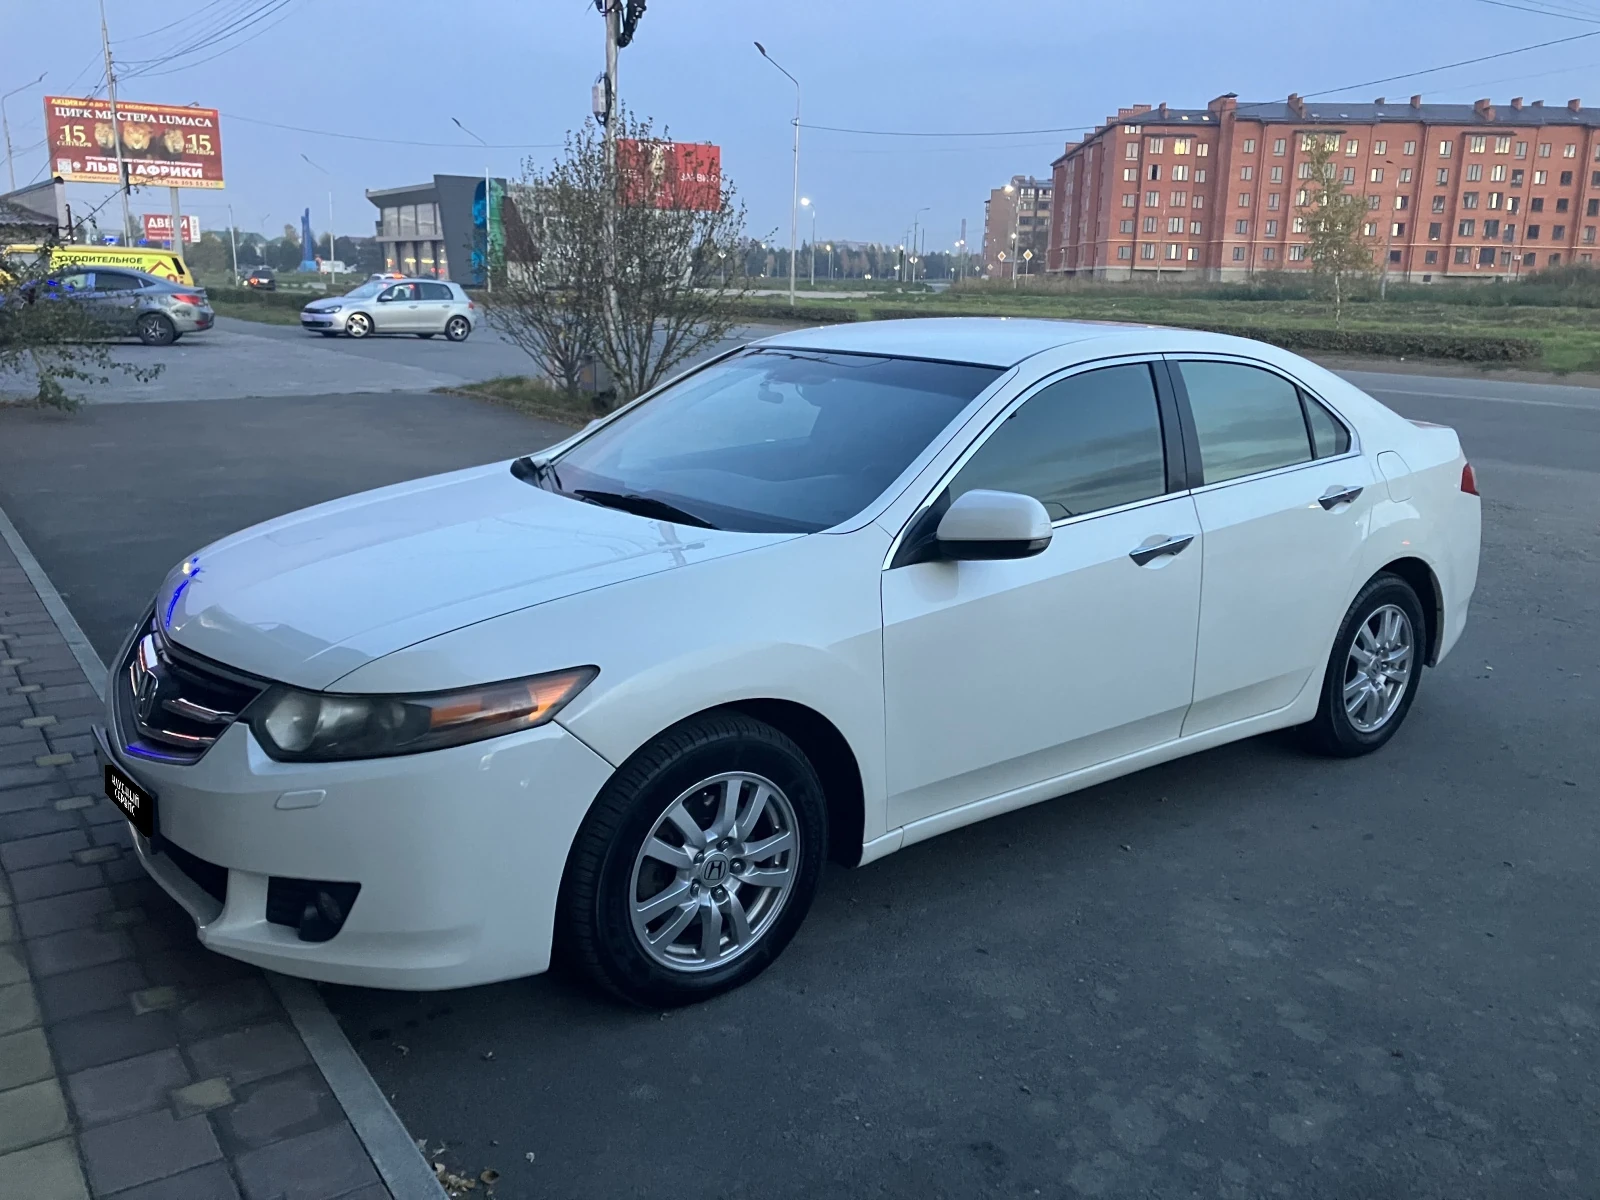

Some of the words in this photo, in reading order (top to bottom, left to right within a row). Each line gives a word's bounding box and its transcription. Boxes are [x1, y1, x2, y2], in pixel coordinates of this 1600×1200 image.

[55, 107, 93, 118] ЦИРК
[159, 115, 213, 128] LUMACA
[60, 124, 86, 144] 15
[187, 134, 211, 153] 15
[135, 164, 203, 179] АФРИКИ
